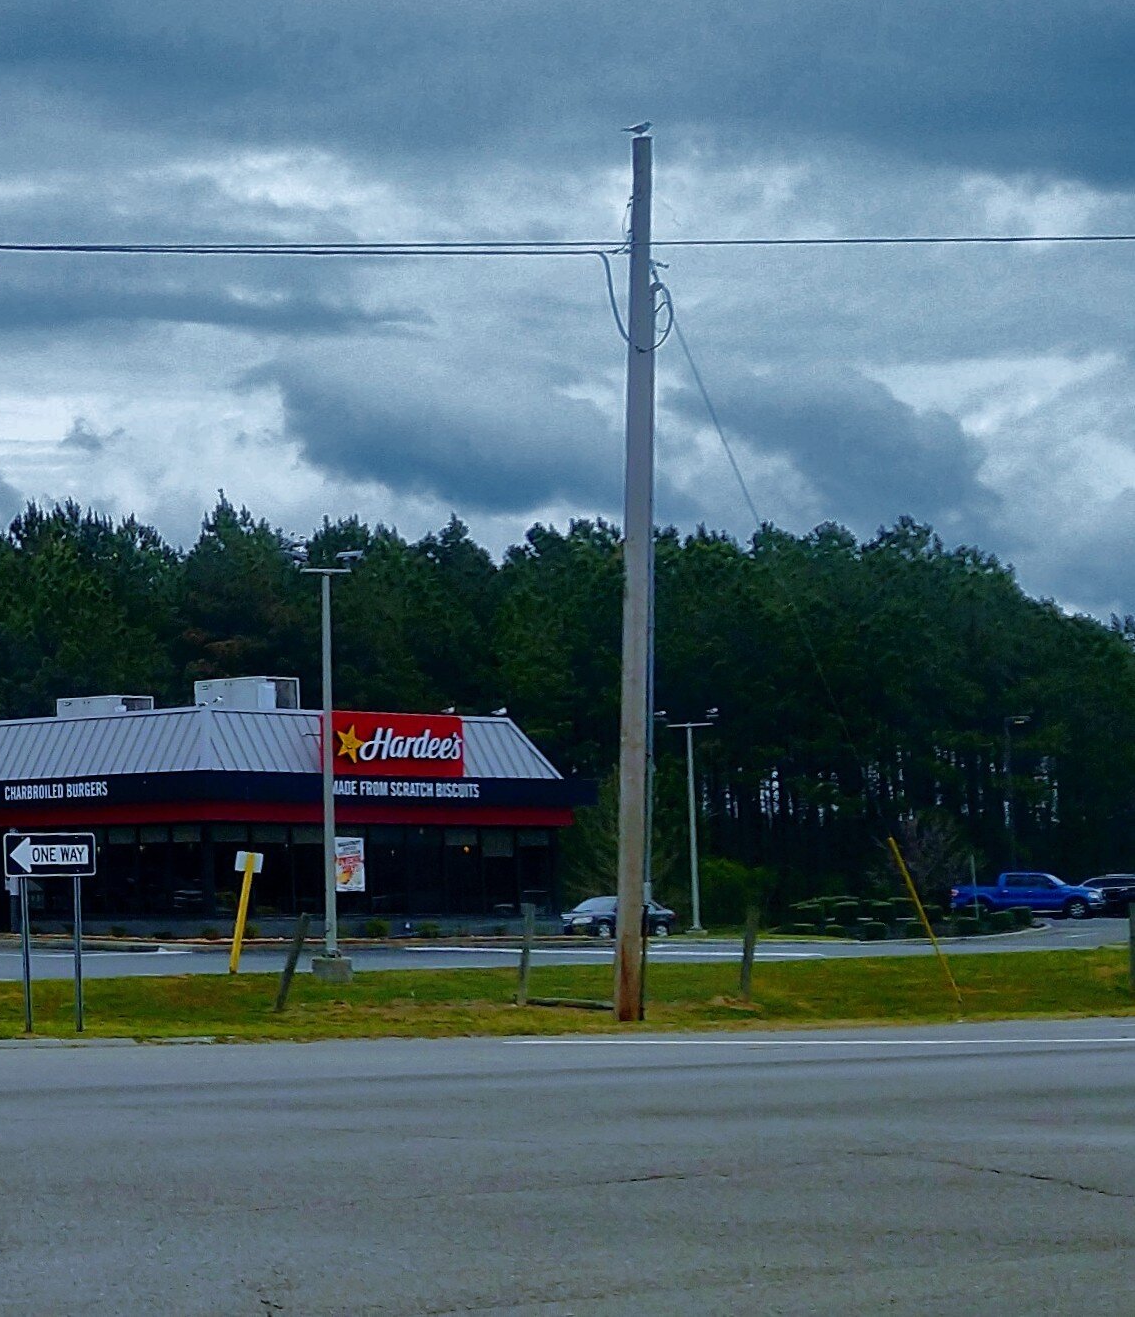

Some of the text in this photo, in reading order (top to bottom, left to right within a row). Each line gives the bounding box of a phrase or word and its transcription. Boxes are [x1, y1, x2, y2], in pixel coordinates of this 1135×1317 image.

[359, 727, 463, 761] Hardee's
[5, 781, 108, 800] CHARBROILED BURGERS
[360, 781, 388, 796] FROM
[390, 782, 433, 797] SCRATCH
[436, 783, 480, 798] BISCUITS
[32, 847, 84, 862] ONE WAY
